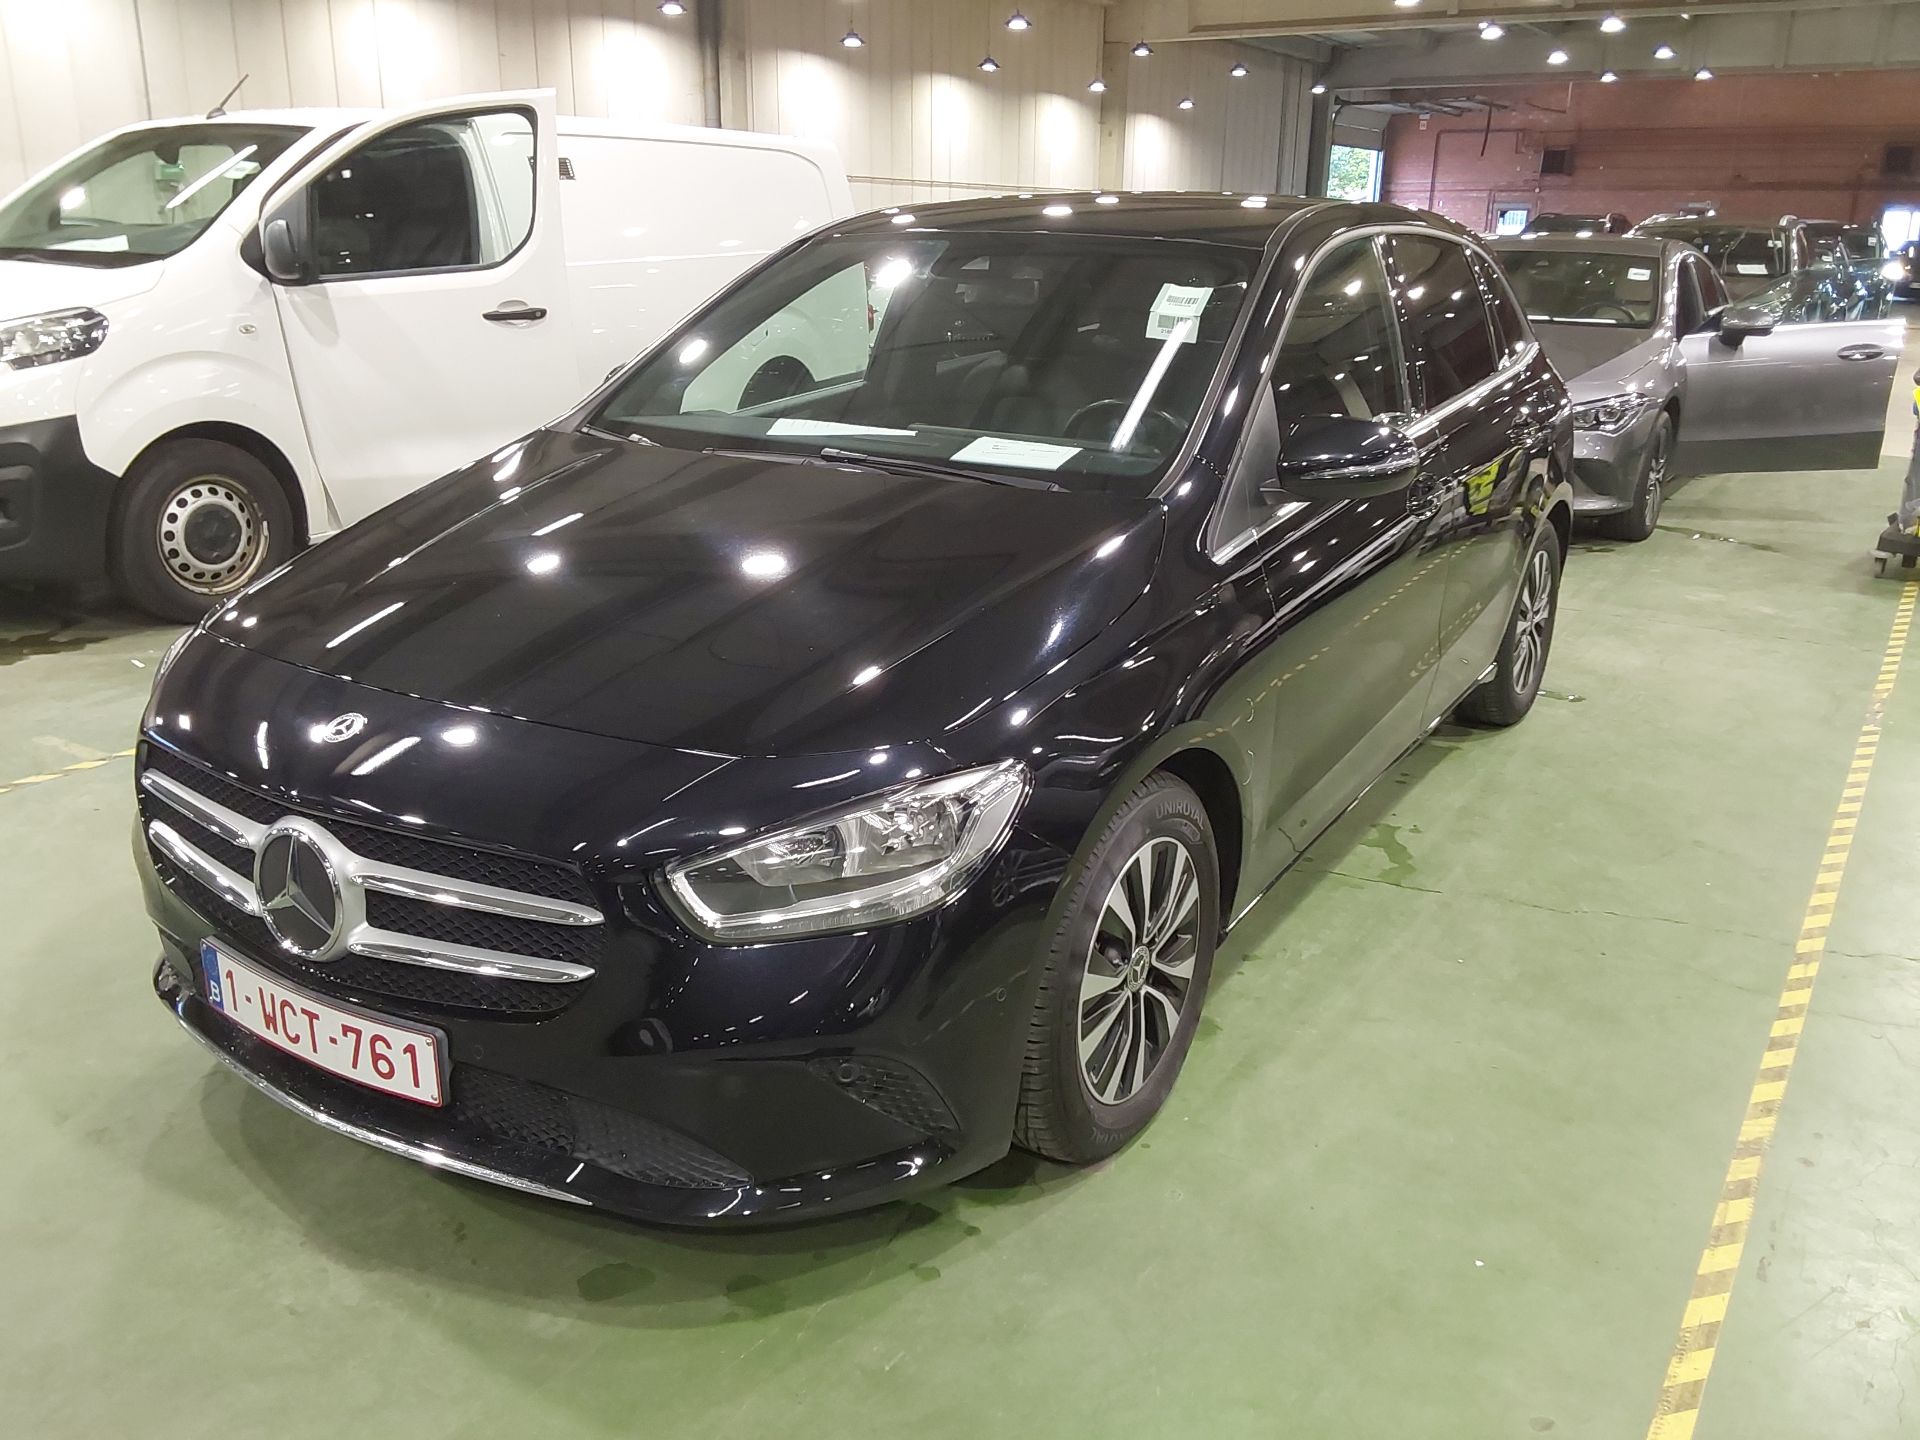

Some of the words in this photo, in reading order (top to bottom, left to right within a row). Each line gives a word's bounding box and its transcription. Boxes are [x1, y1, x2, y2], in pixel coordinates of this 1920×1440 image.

[1155, 800, 1204, 830] UNIROYAL
[210, 981, 221, 1003] B
[225, 970, 420, 1089] 1-WCT-761
